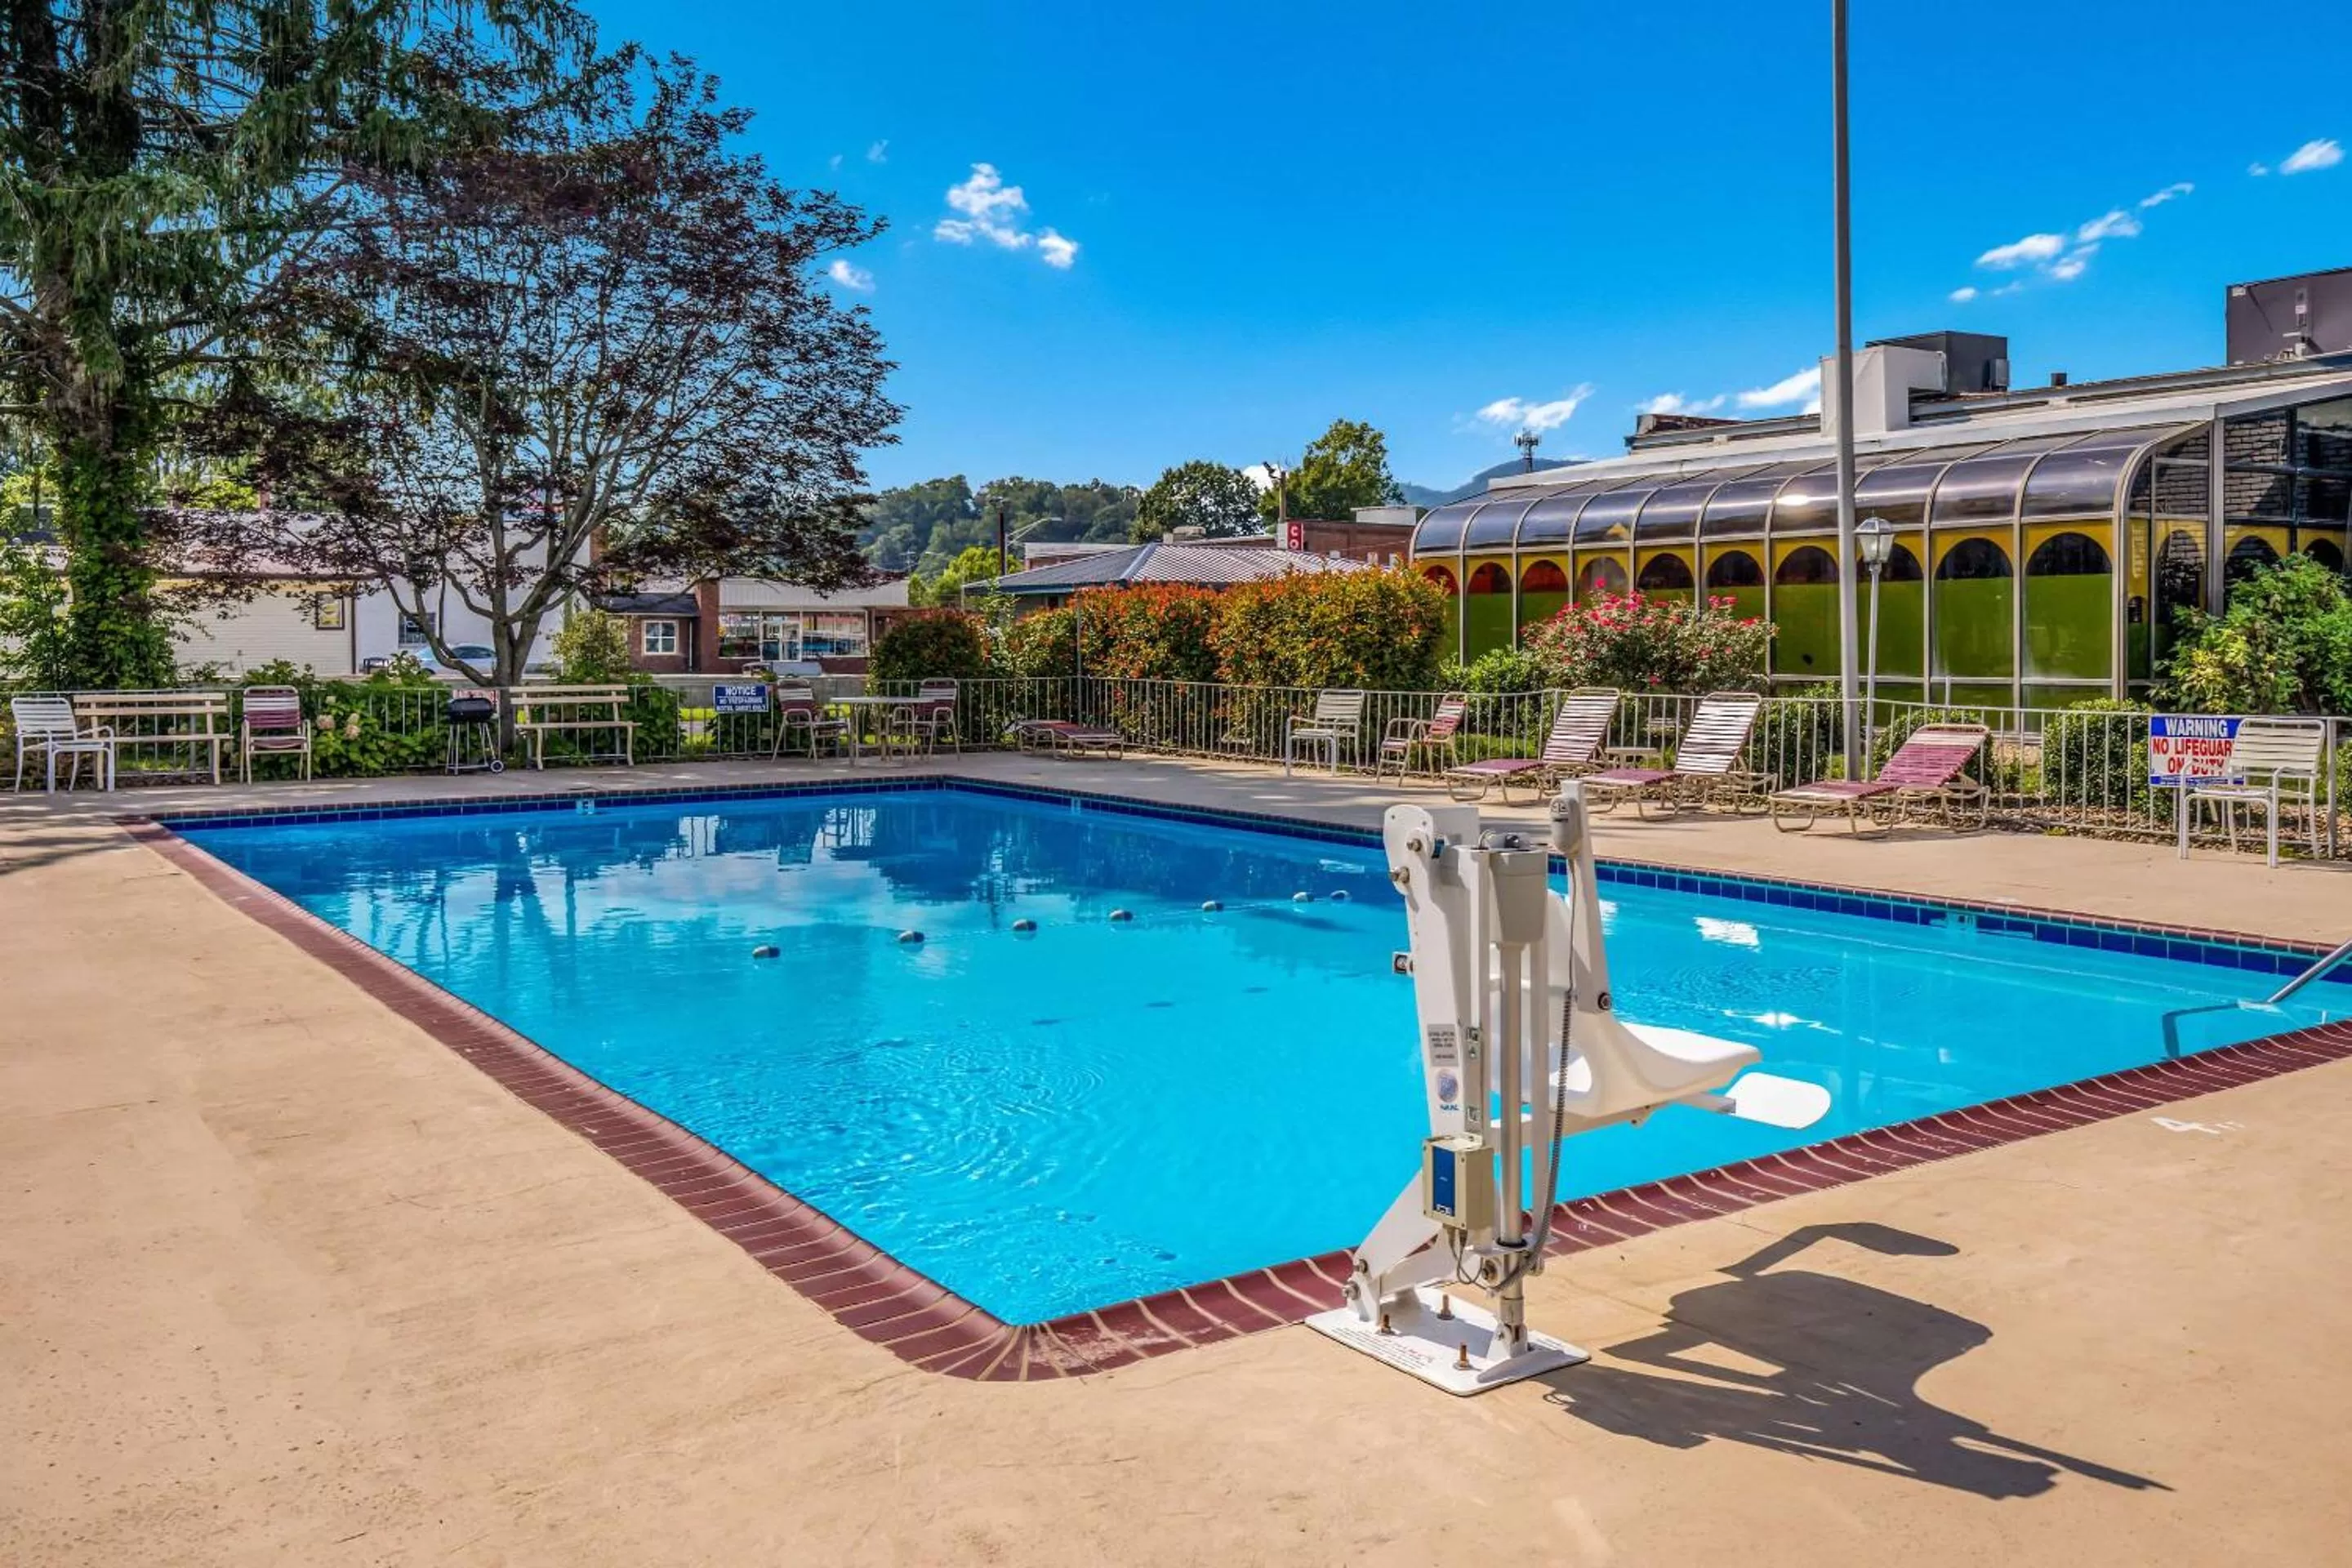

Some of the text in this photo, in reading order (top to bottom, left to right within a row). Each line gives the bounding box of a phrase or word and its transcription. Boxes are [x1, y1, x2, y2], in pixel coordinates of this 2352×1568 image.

[725, 686, 756, 697] NOTICE
[2164, 718, 2228, 737] WARNING
[2152, 738, 2235, 757] NO LIFEGUAR
[2167, 757, 2225, 776] ON DUTY
